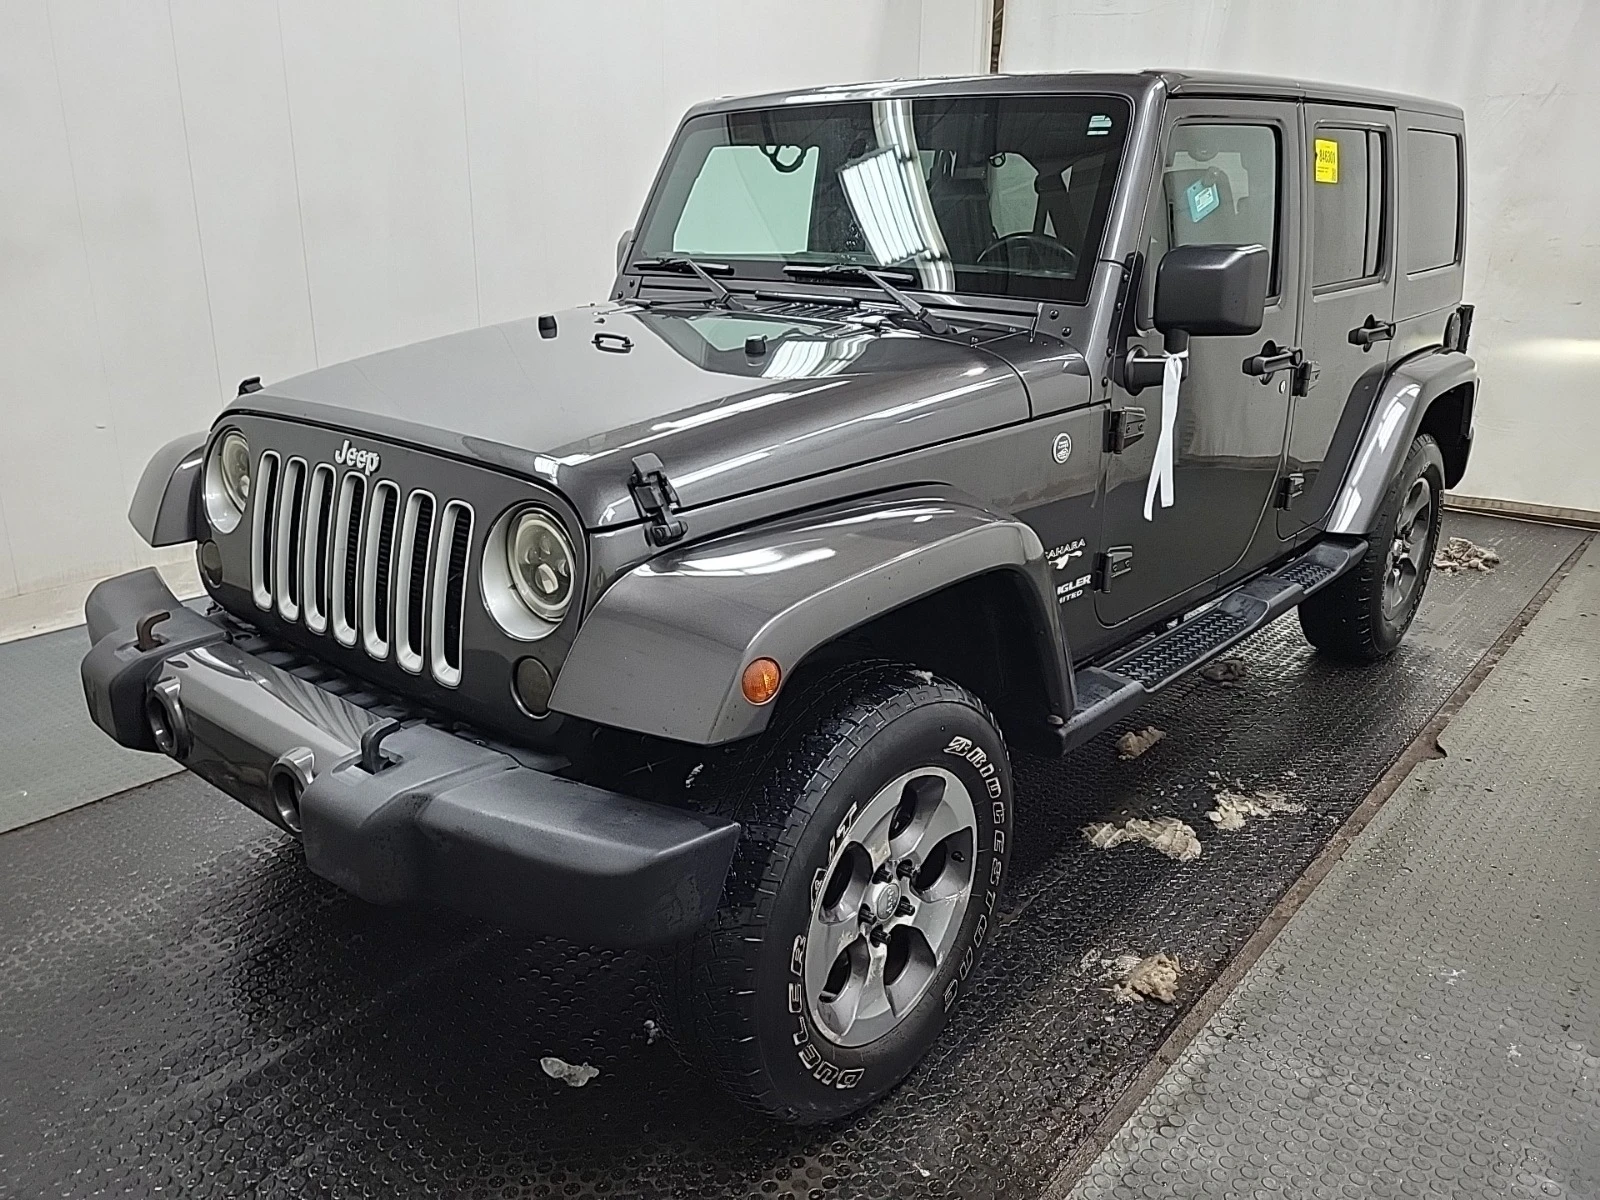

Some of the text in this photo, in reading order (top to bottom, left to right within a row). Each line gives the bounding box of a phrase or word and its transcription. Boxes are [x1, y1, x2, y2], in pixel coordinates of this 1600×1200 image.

[335, 439, 380, 477] Jeep
[943, 735, 1005, 1013] BRIDGESTONE
[788, 934, 865, 1089] DUELER
